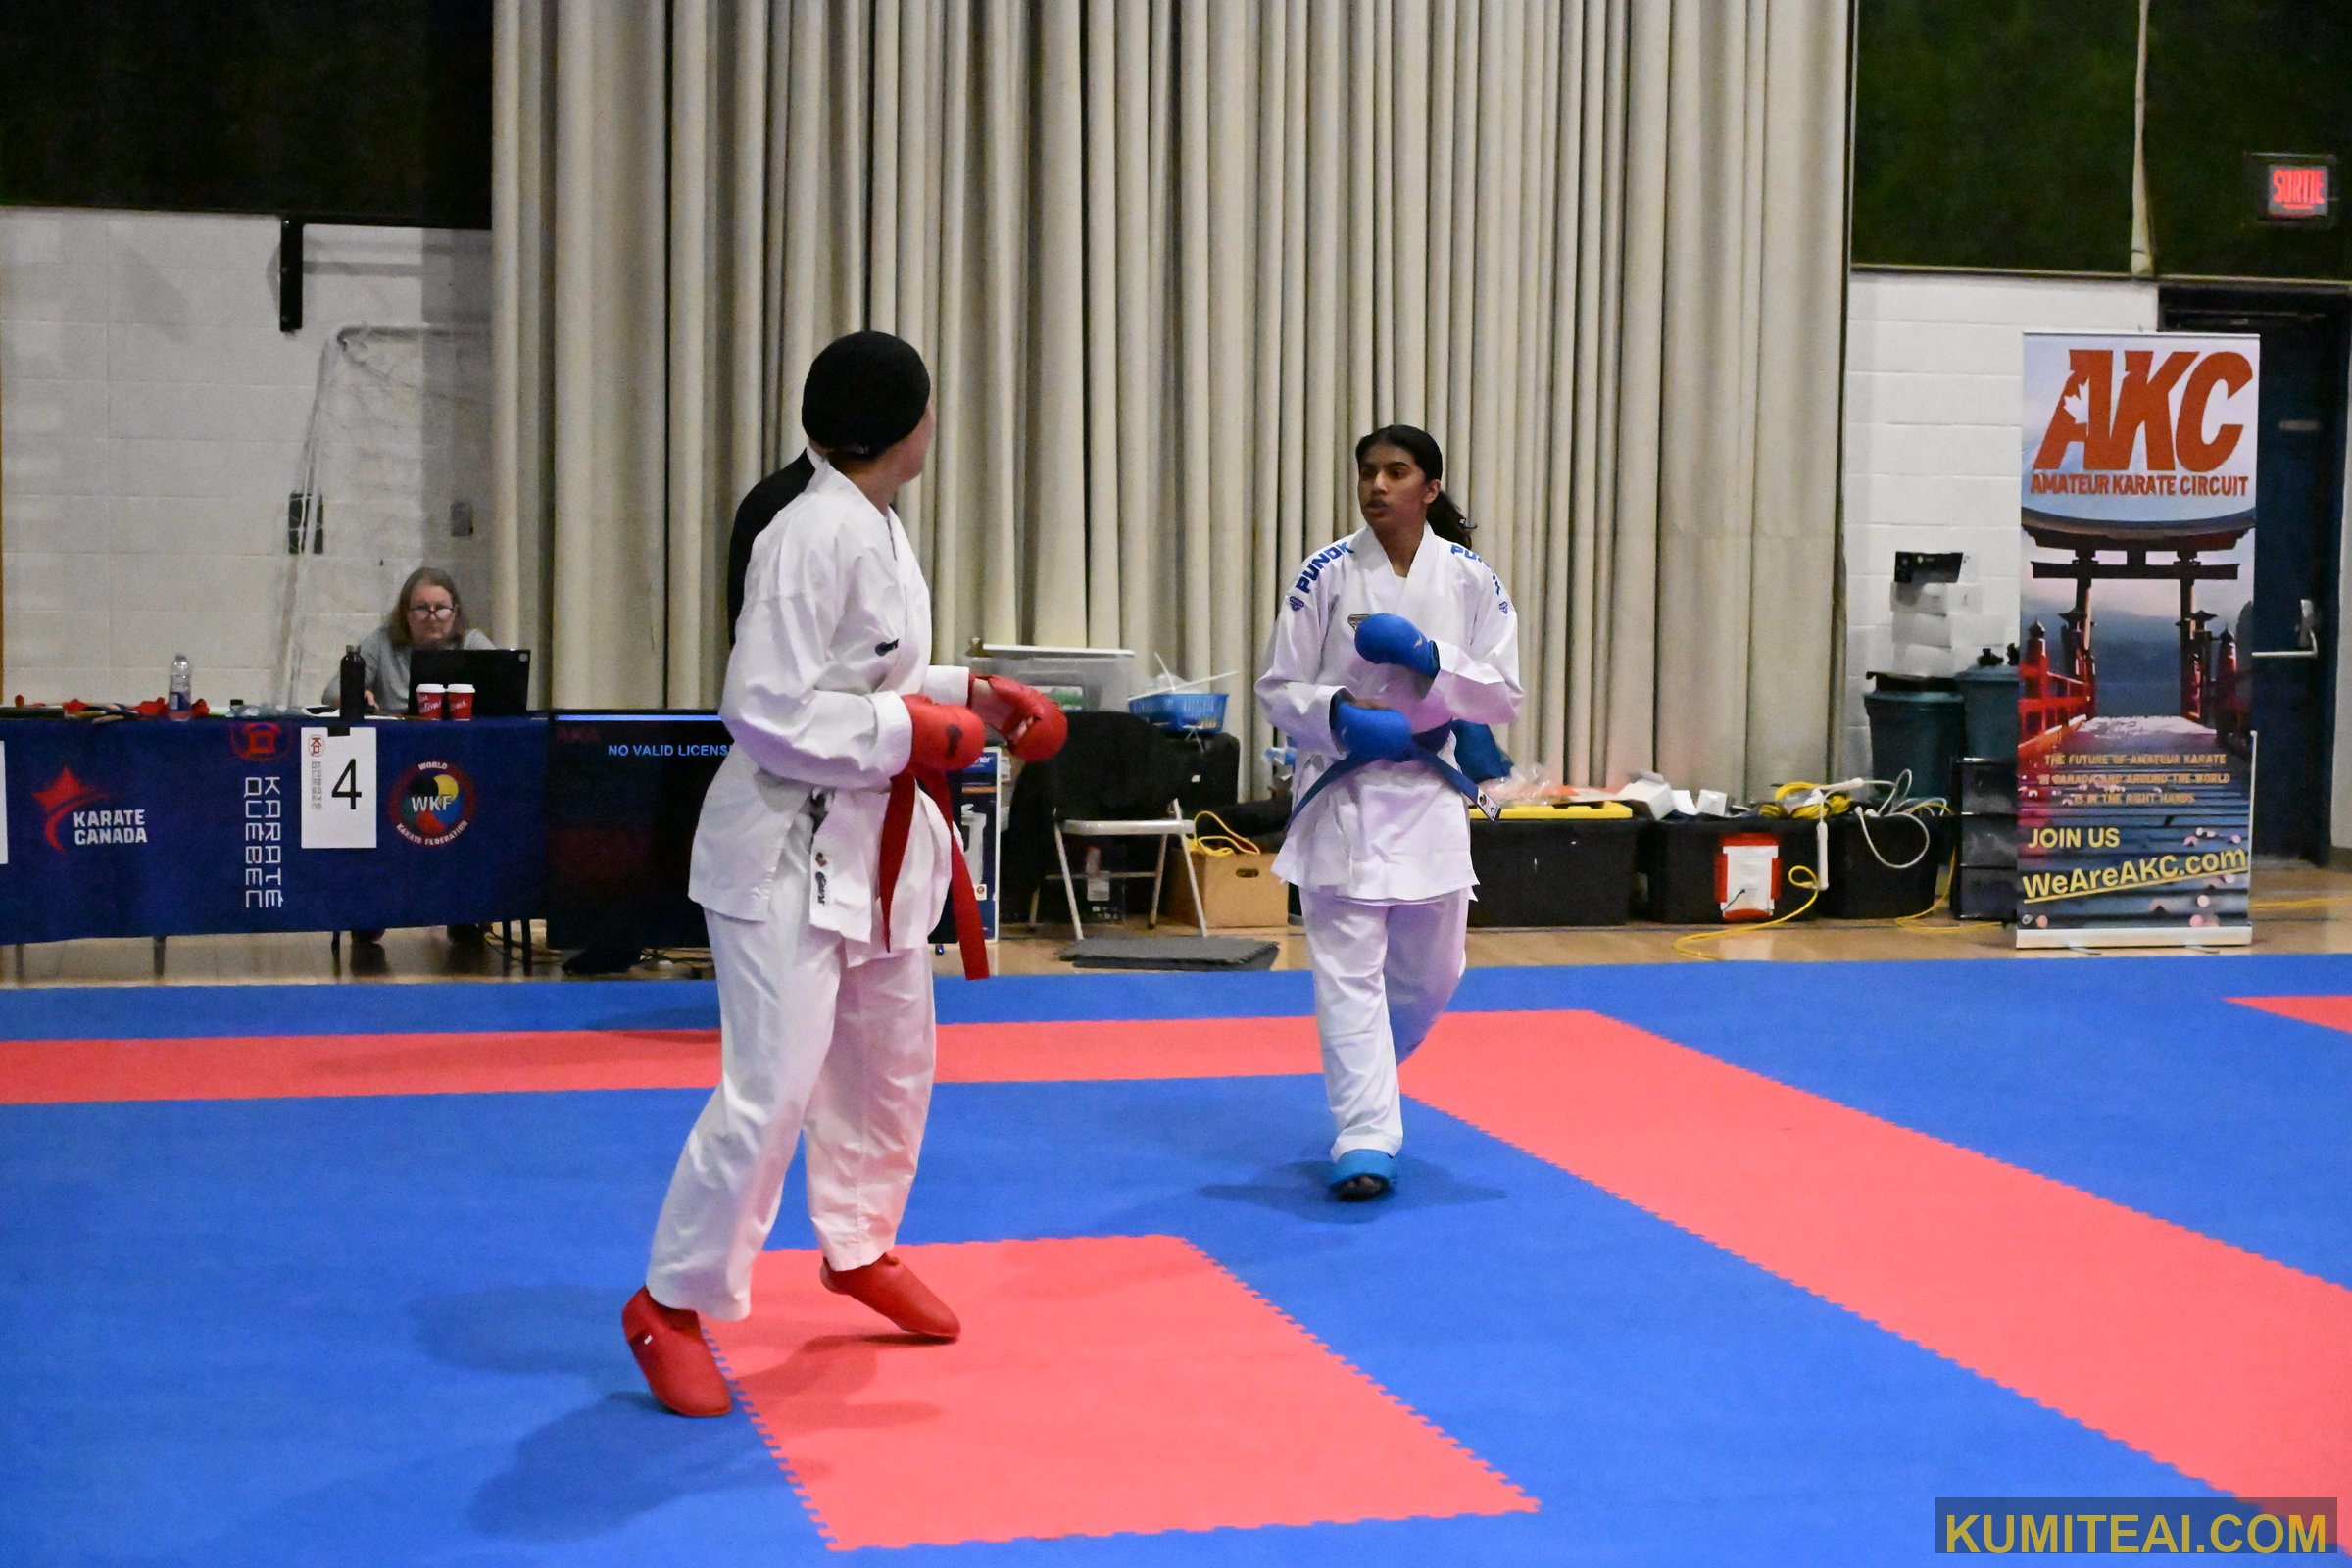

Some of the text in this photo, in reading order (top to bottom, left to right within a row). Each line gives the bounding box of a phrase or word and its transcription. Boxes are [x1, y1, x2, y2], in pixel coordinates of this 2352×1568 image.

[2274, 169, 2325, 204] SORTIE
[2033, 349, 2253, 472] AKC
[2031, 473, 2249, 497] AMATEUR KARATE CIRCUIT
[608, 745, 730, 757] NO VALID LICENS
[2044, 754, 2227, 765] THE FUTURE OF AMATEUR KARATE
[418, 761, 448, 771] WORLD
[331, 758, 362, 810] 4
[2052, 774, 2095, 785] CANADA
[2171, 773, 2191, 784] THE
[2195, 773, 2230, 784] WORLD
[412, 796, 453, 812] WKF
[2103, 793, 2121, 804] THE
[2126, 793, 2155, 805] RIGHT
[2160, 793, 2196, 804] HANDS
[74, 809, 146, 828] KARATE
[74, 827, 148, 846] CANADA
[265, 777, 283, 908] KARATÉ
[2028, 828, 2120, 849] JOIN US
[2022, 848, 2247, 899] WeAreAKC.com
